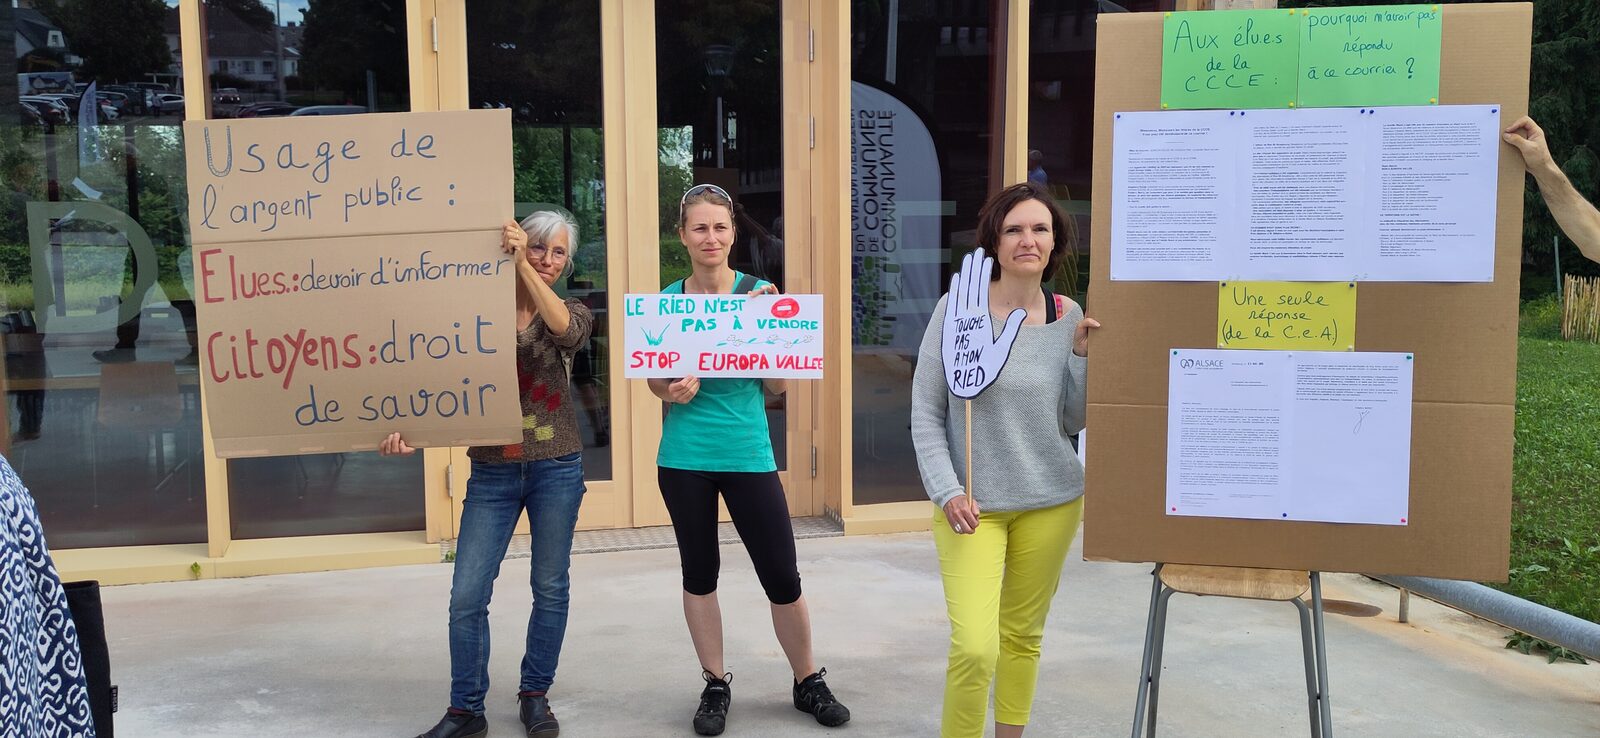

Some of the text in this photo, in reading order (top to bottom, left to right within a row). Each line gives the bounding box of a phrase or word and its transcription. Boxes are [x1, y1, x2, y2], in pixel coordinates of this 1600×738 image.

[1174, 20, 1218, 53] Aux
[1308, 11, 1436, 42] pourquoi m'avoir pas
[1343, 36, 1393, 58] répondu
[1206, 53, 1250, 72] de la
[1323, 67, 1339, 77] ce
[1344, 64, 1396, 76] courrier
[204, 125, 437, 183] Usage de
[201, 184, 322, 232] l'argent
[345, 176, 423, 222] public
[370, 251, 510, 285] d'informer
[626, 298, 644, 316] LE
[705, 297, 746, 314] N'EST
[1233, 286, 1329, 306] Une seule
[681, 315, 818, 332] PAS À VENDRE
[954, 314, 986, 333] TOUCHE
[1248, 308, 1312, 327] réponse
[380, 315, 497, 364] droit
[954, 333, 970, 350] PAS
[1222, 318, 1248, 344] (de
[1255, 326, 1275, 338] la
[630, 351, 680, 369] STOP
[698, 352, 769, 371] EUROPA
[1195, 359, 1223, 367] ALSACE
[953, 365, 985, 390] RIED
[295, 378, 497, 426] de savoir
